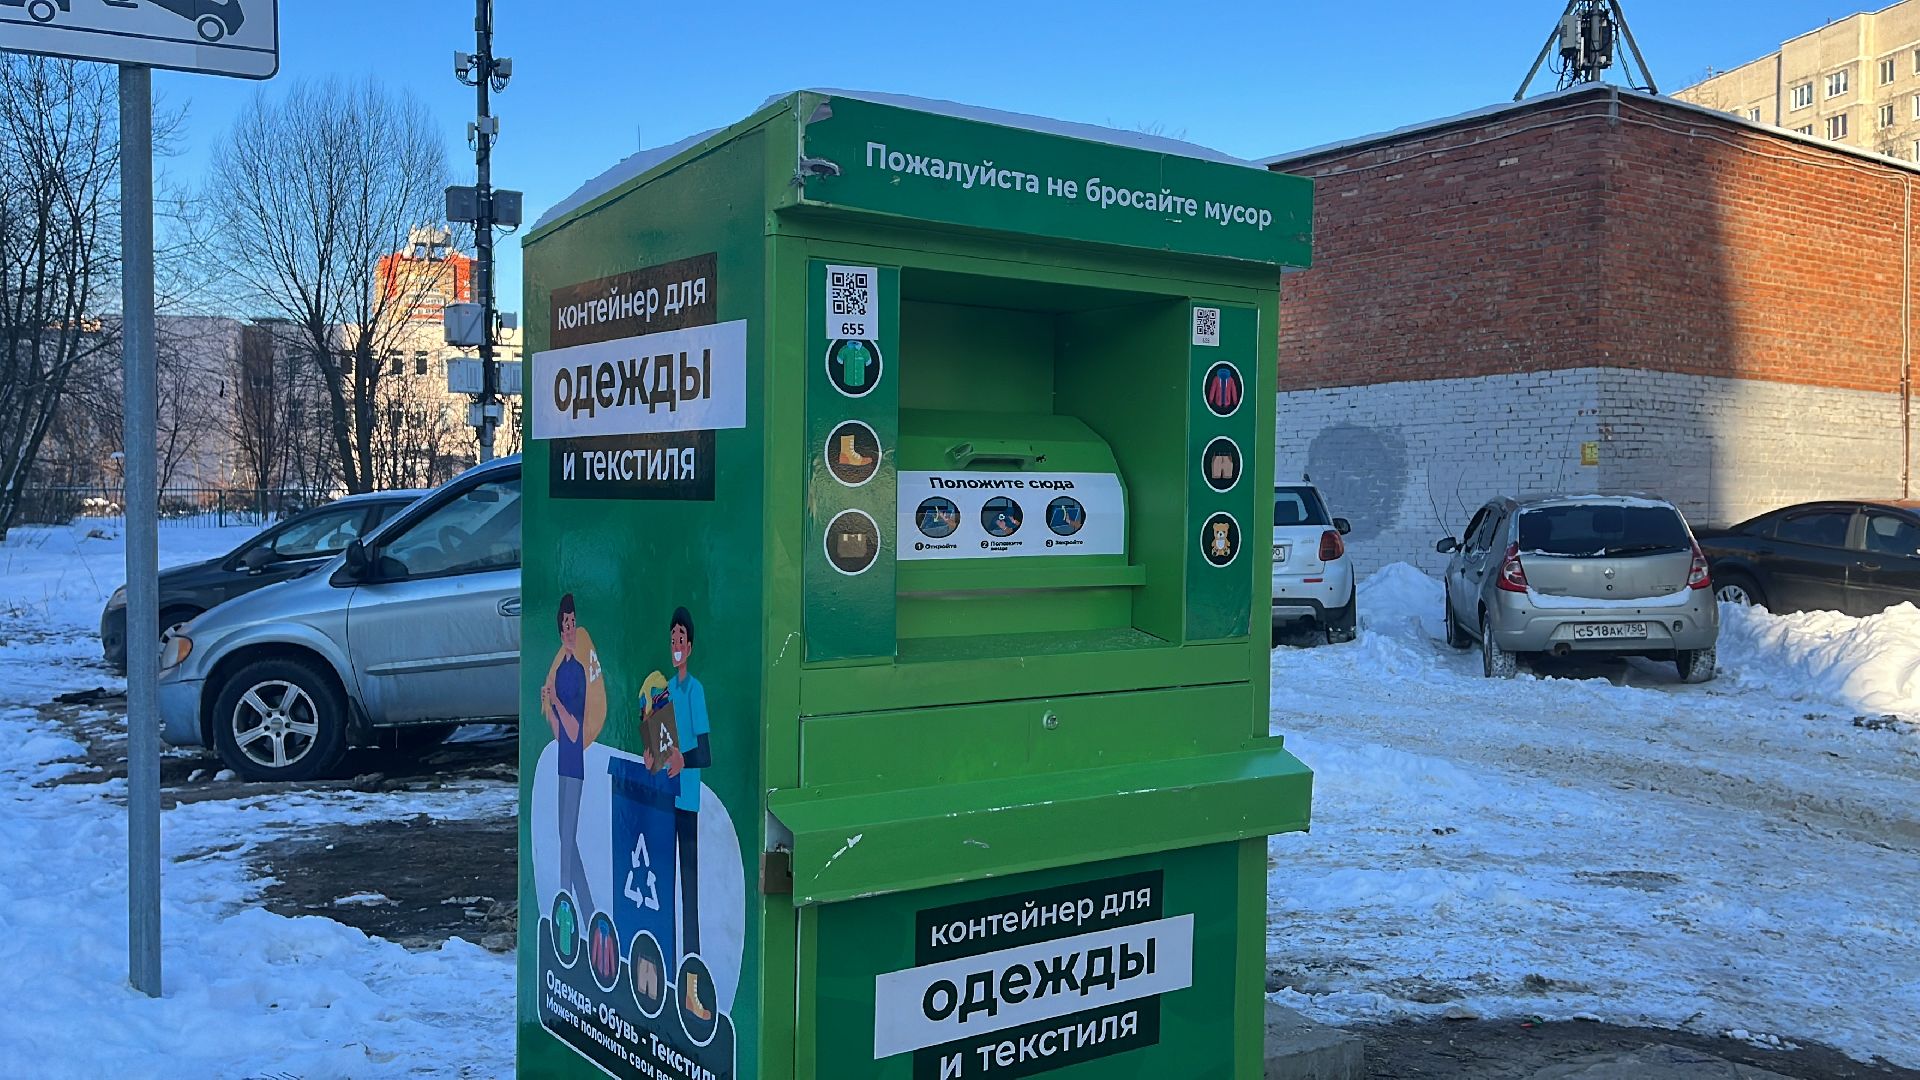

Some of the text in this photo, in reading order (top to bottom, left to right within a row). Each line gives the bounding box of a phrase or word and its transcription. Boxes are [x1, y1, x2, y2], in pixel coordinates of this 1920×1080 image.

[866, 141, 1272, 231] Пожалуйста не бросайте мусор
[558, 277, 706, 331] контейнер для
[841, 322, 865, 336] 655
[554, 348, 711, 420] одежды
[563, 447, 695, 481] и текстиля
[929, 477, 1075, 491] Положите сюда
[931, 887, 1151, 947] контейнер для
[546, 969, 592, 1015] Одежда
[598, 1002, 639, 1045] Обувь
[922, 938, 1156, 1023] одежды
[546, 993, 579, 1028] Можете
[581, 1021, 628, 1060] положить
[629, 1052, 654, 1078] свои
[939, 1010, 1139, 1080] и текстиля
